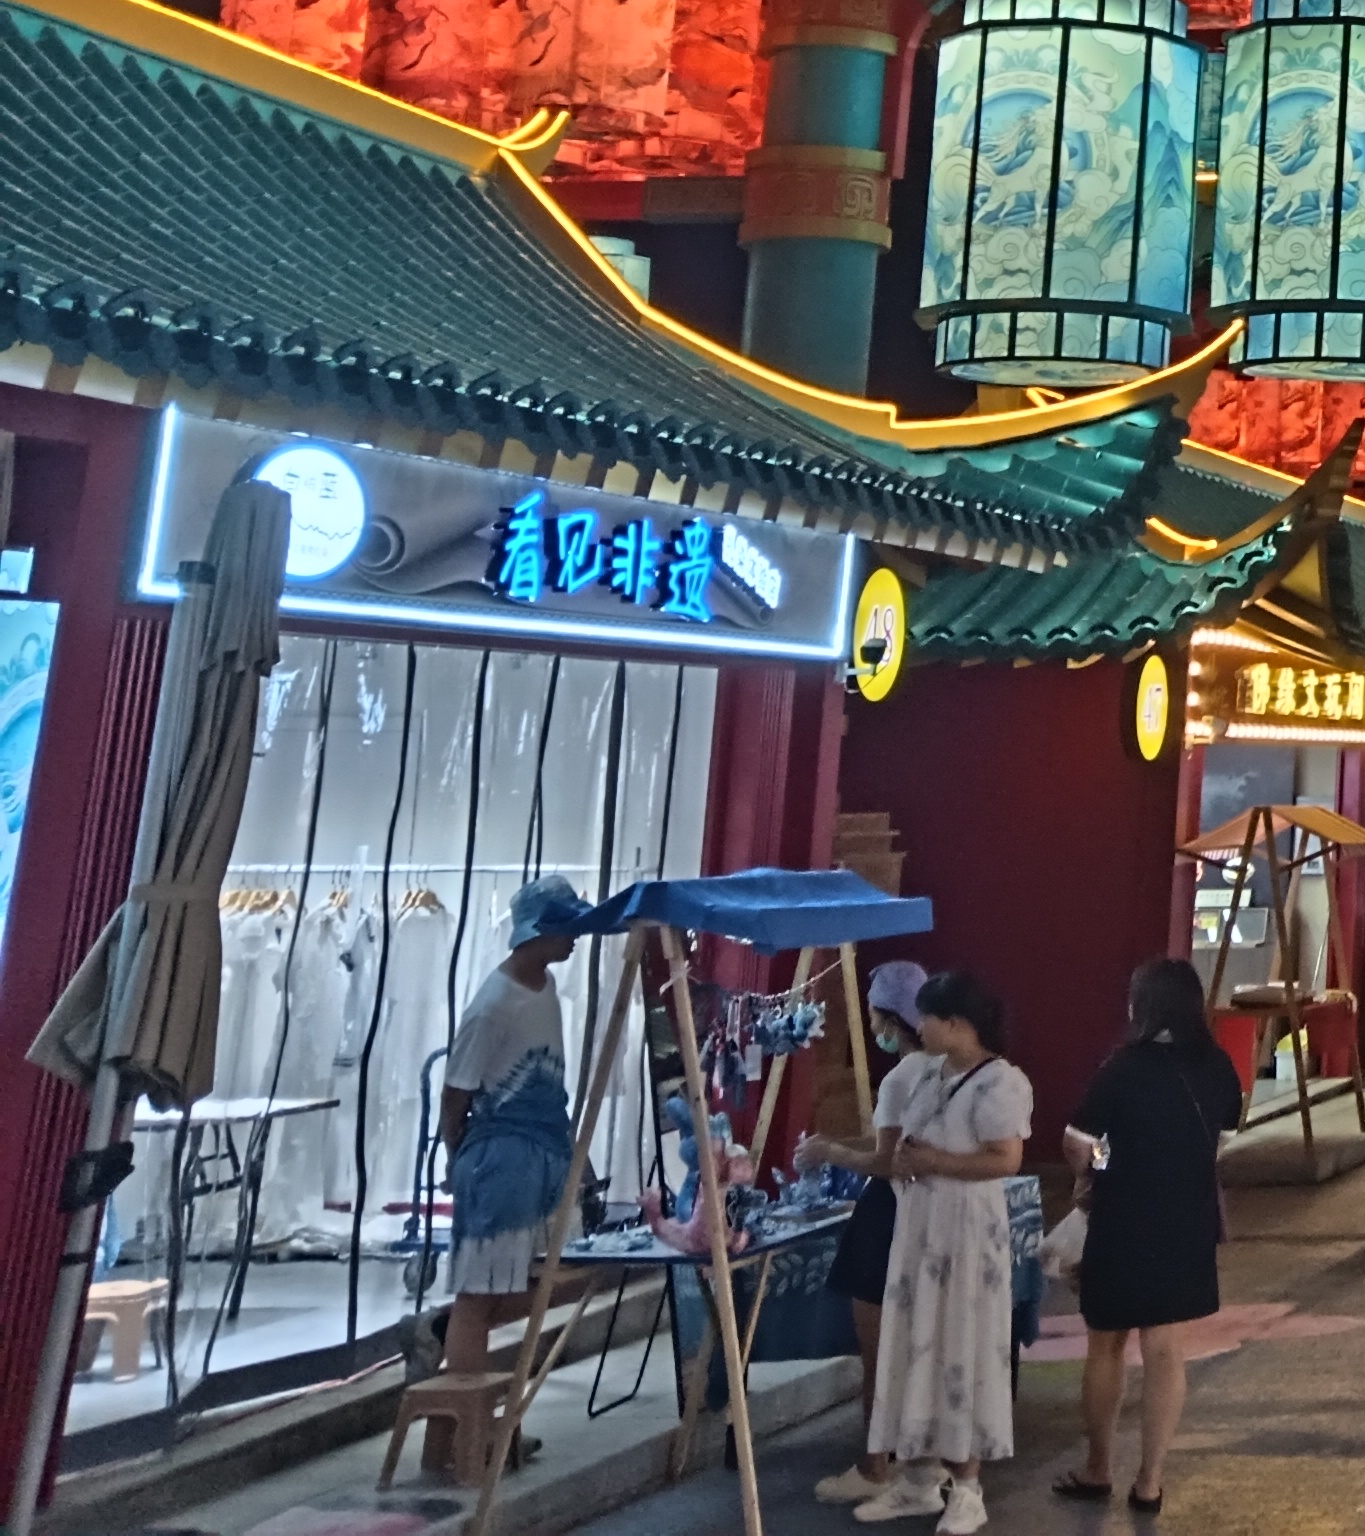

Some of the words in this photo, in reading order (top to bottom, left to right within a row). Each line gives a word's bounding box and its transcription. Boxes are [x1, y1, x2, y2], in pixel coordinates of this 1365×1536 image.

[500, 490, 712, 622] 看见非遗
[1142, 686, 1163, 732] 47
